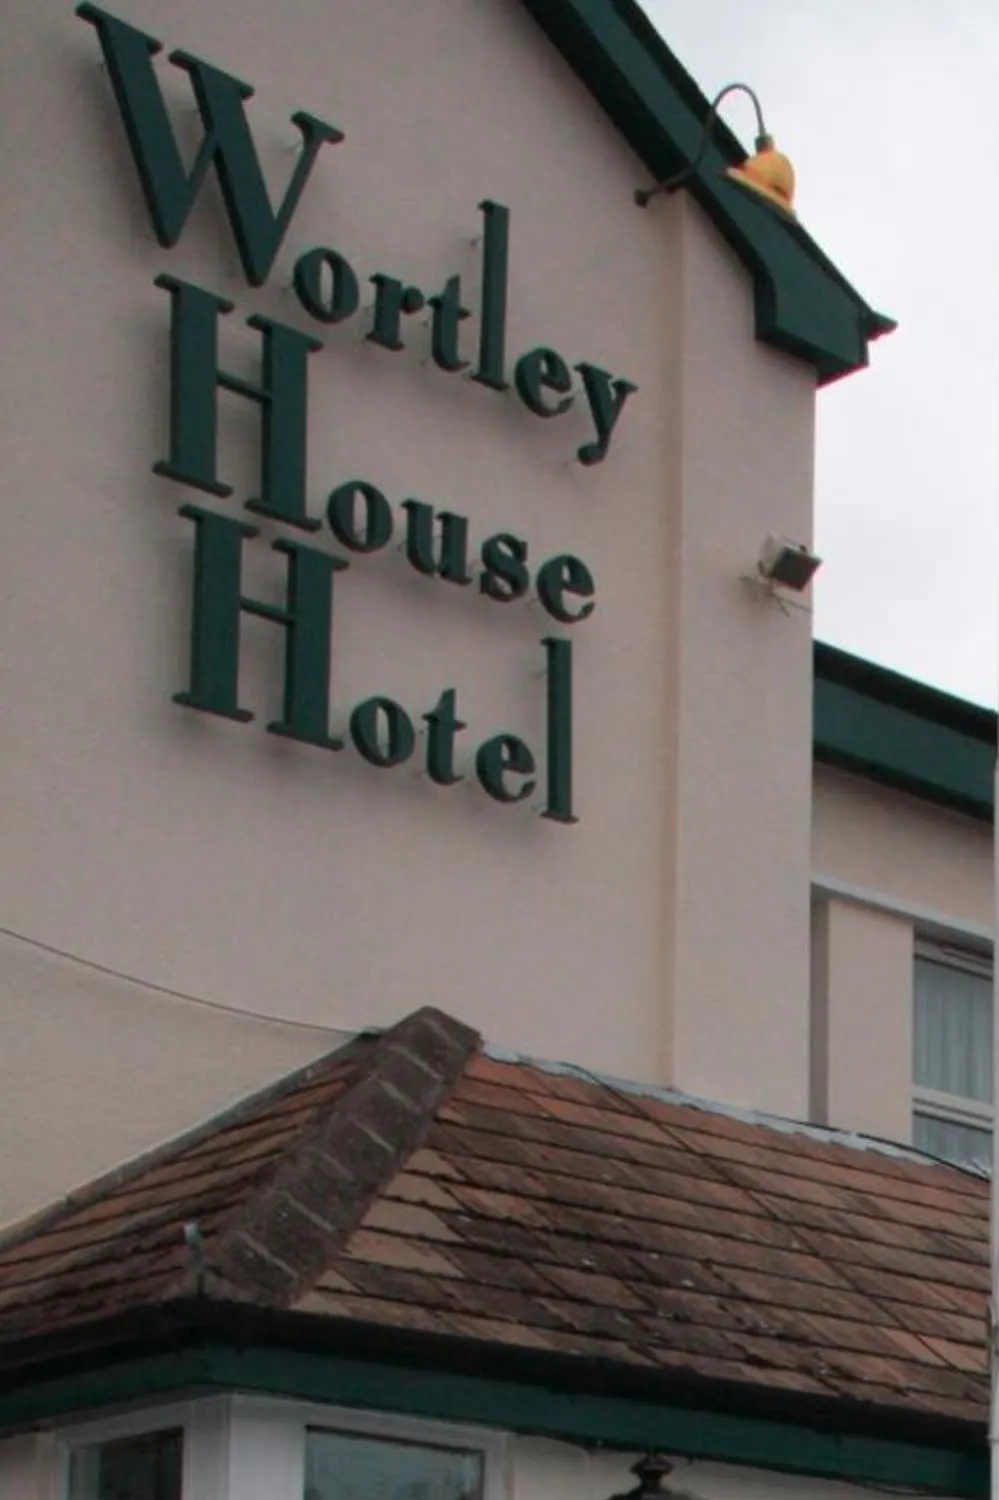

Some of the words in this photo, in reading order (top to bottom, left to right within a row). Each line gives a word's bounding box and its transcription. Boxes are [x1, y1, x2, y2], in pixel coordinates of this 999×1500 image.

[76, 1, 638, 466] Wortley
[153, 272, 596, 624] House
[171, 504, 580, 824] Hotel
